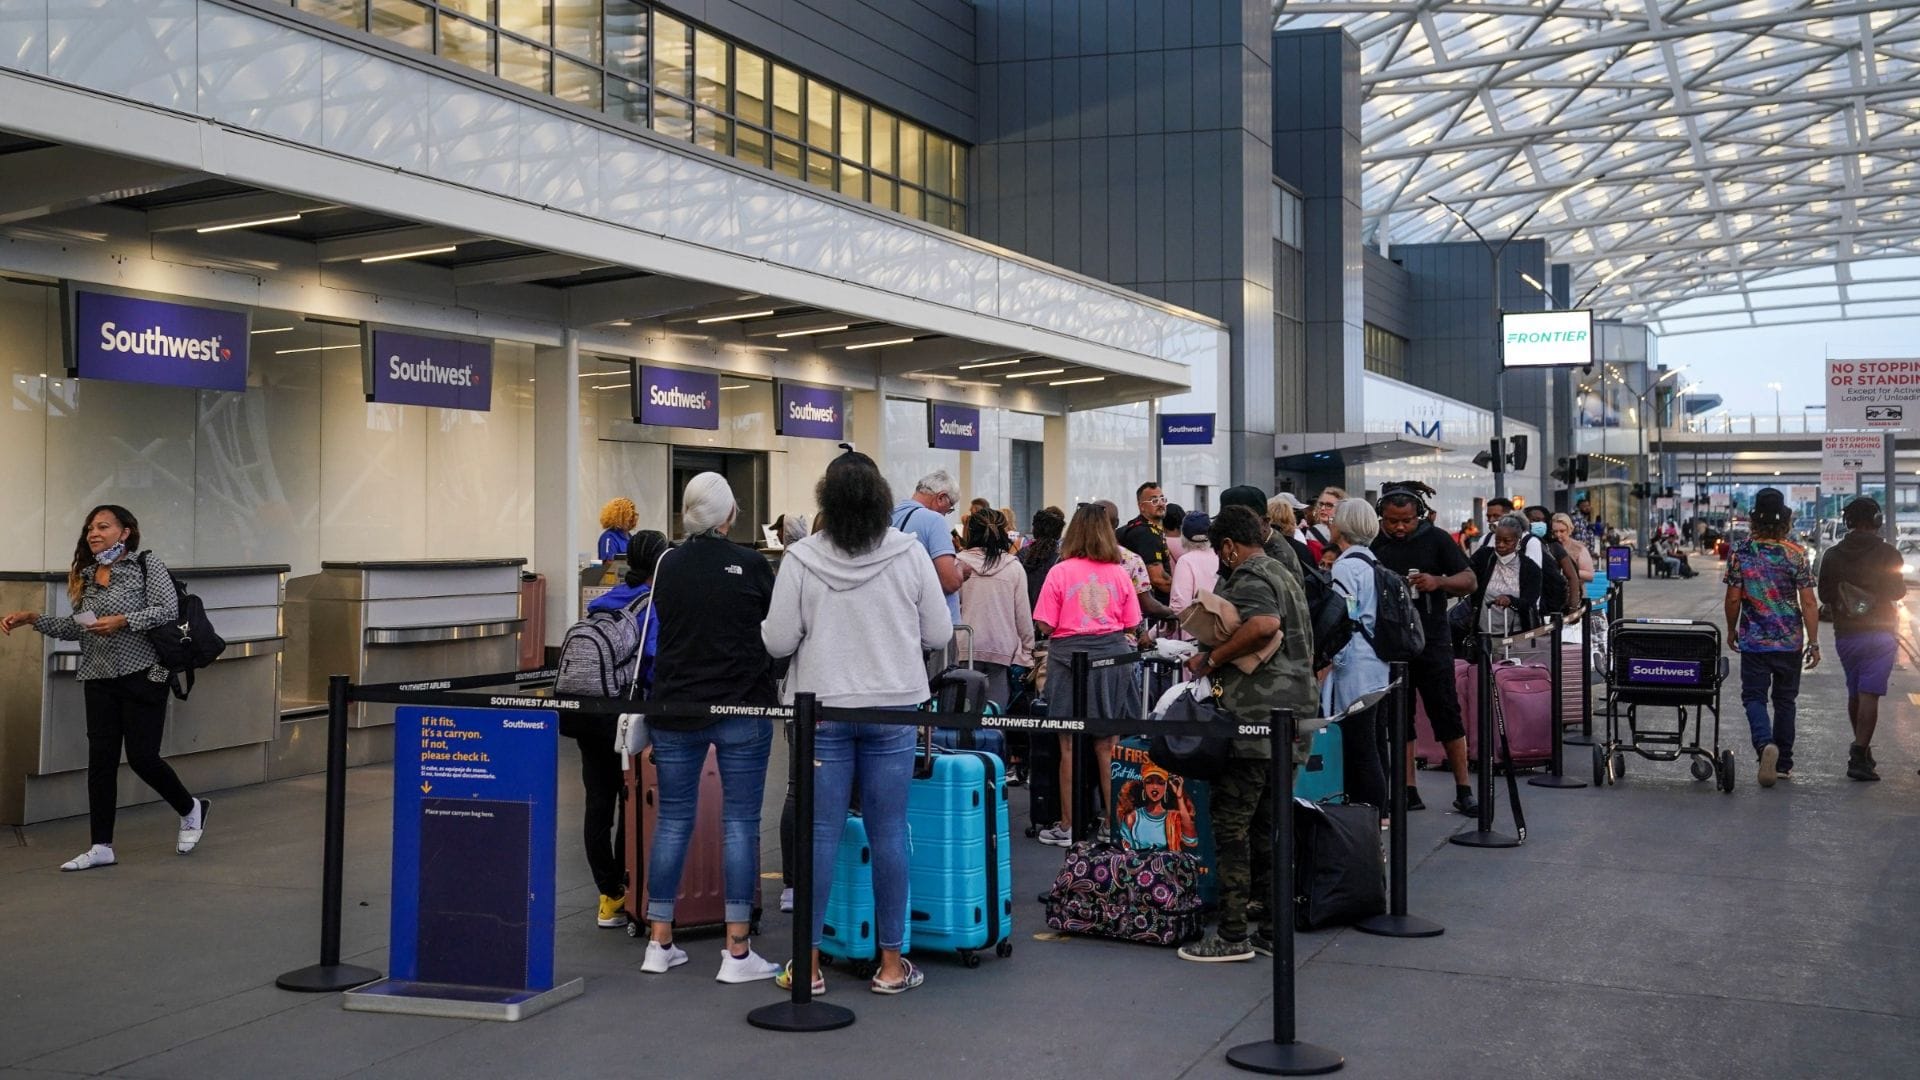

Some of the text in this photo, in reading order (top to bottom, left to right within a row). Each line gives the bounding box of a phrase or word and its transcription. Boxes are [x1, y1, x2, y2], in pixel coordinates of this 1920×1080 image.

[101, 321, 220, 362] Southwest
[1507, 330, 1587, 344] FRONTIER
[390, 355, 471, 387] Southwest
[1832, 363, 1854, 373] NO
[1831, 376, 1853, 386] OR
[1848, 387, 1876, 395] Except
[650, 385, 706, 410] Southwest
[789, 401, 834, 423] Southwest
[940, 418, 973, 437] Southwest
[1168, 425, 1203, 433] Southwest
[1633, 665, 1695, 677] Southwest
[490, 696, 580, 709] SOUTHWEST AIRLINES
[710, 705, 794, 717] SOUTHWEST AIRLIN
[421, 717, 456, 728] If it fits,
[503, 719, 545, 729] Southwest
[981, 716, 1085, 730] SOUTHWEST AIRLINES
[421, 728, 482, 740] it's a carryon.
[421, 739, 448, 750] If not,
[421, 750, 490, 762] please check it.
[451, 810, 471, 818] carryon
[471, 810, 481, 818] bag
